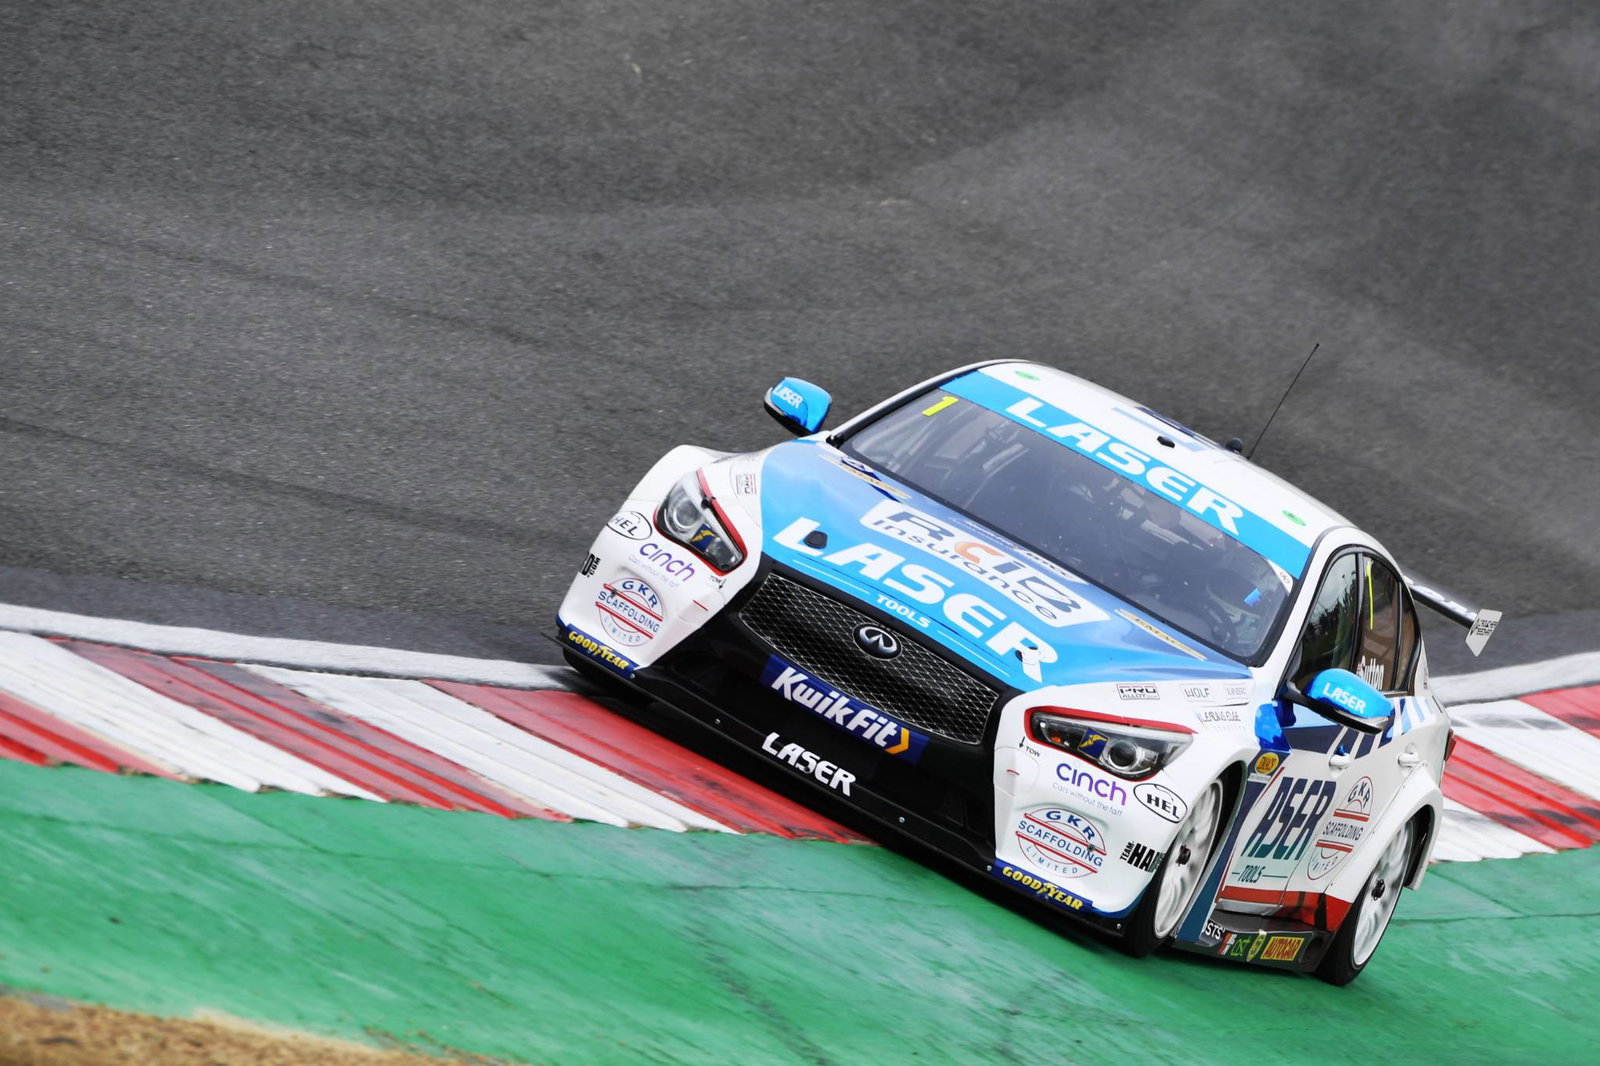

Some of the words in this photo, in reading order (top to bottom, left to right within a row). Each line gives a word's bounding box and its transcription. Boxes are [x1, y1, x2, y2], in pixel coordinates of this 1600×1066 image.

[772, 384, 804, 408] LASER
[922, 396, 959, 416] 1
[1005, 398, 1244, 535] LASER
[615, 516, 638, 537] HEL
[639, 542, 696, 582] cinch
[622, 580, 658, 609] GKR
[772, 516, 1058, 684] LASER
[598, 590, 660, 633] SCAFFOLDING
[877, 594, 931, 629] TOOLS
[568, 630, 630, 671] GOODYEAR
[1184, 687, 1210, 698] WOLF
[1322, 682, 1367, 714] LASER
[761, 732, 856, 797] LASER
[1056, 763, 1127, 806] cinch
[1347, 781, 1371, 810] GKR
[1146, 793, 1180, 820] HEL
[1045, 810, 1096, 841] GKR
[1018, 820, 1104, 867] SCAFFOLDING
[1026, 845, 1078, 874] LIMITED
[1002, 867, 1084, 911] GOODYEAR
[1238, 865, 1266, 884] TOOLS
